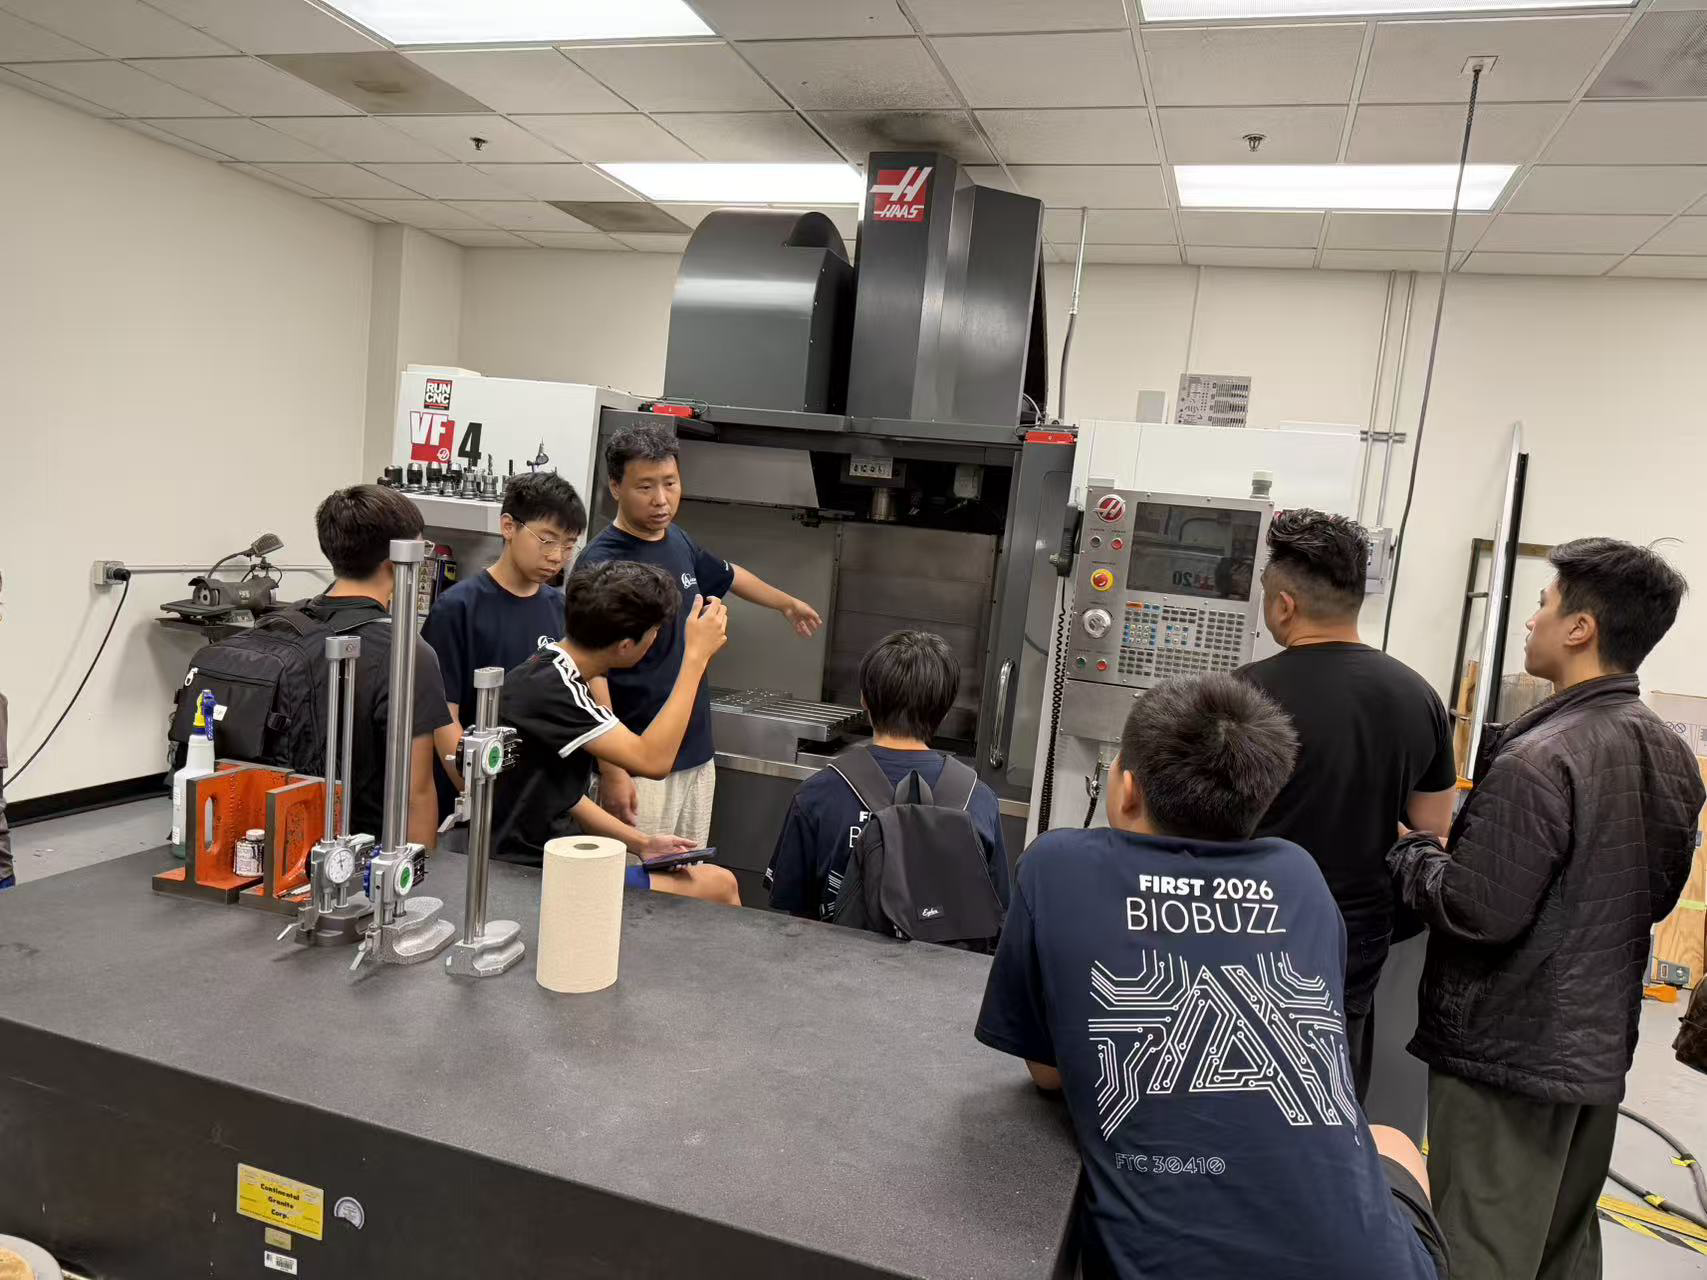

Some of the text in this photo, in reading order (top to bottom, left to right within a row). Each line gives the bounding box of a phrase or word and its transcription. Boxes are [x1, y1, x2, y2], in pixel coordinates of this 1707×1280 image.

[873, 204, 925, 219] HAAS
[426, 383, 451, 394] RUN
[425, 392, 450, 404] CNC
[410, 411, 483, 467] VF 4
[1139, 874, 1274, 900] FIRST 2026
[1126, 897, 1287, 934] BIOBUZZ
[1115, 1152, 1226, 1175] FTC 30410
[260, 1183, 300, 1201] Continental
[268, 1196, 294, 1209] Granite
[271, 1209, 289, 1219] Corp.
